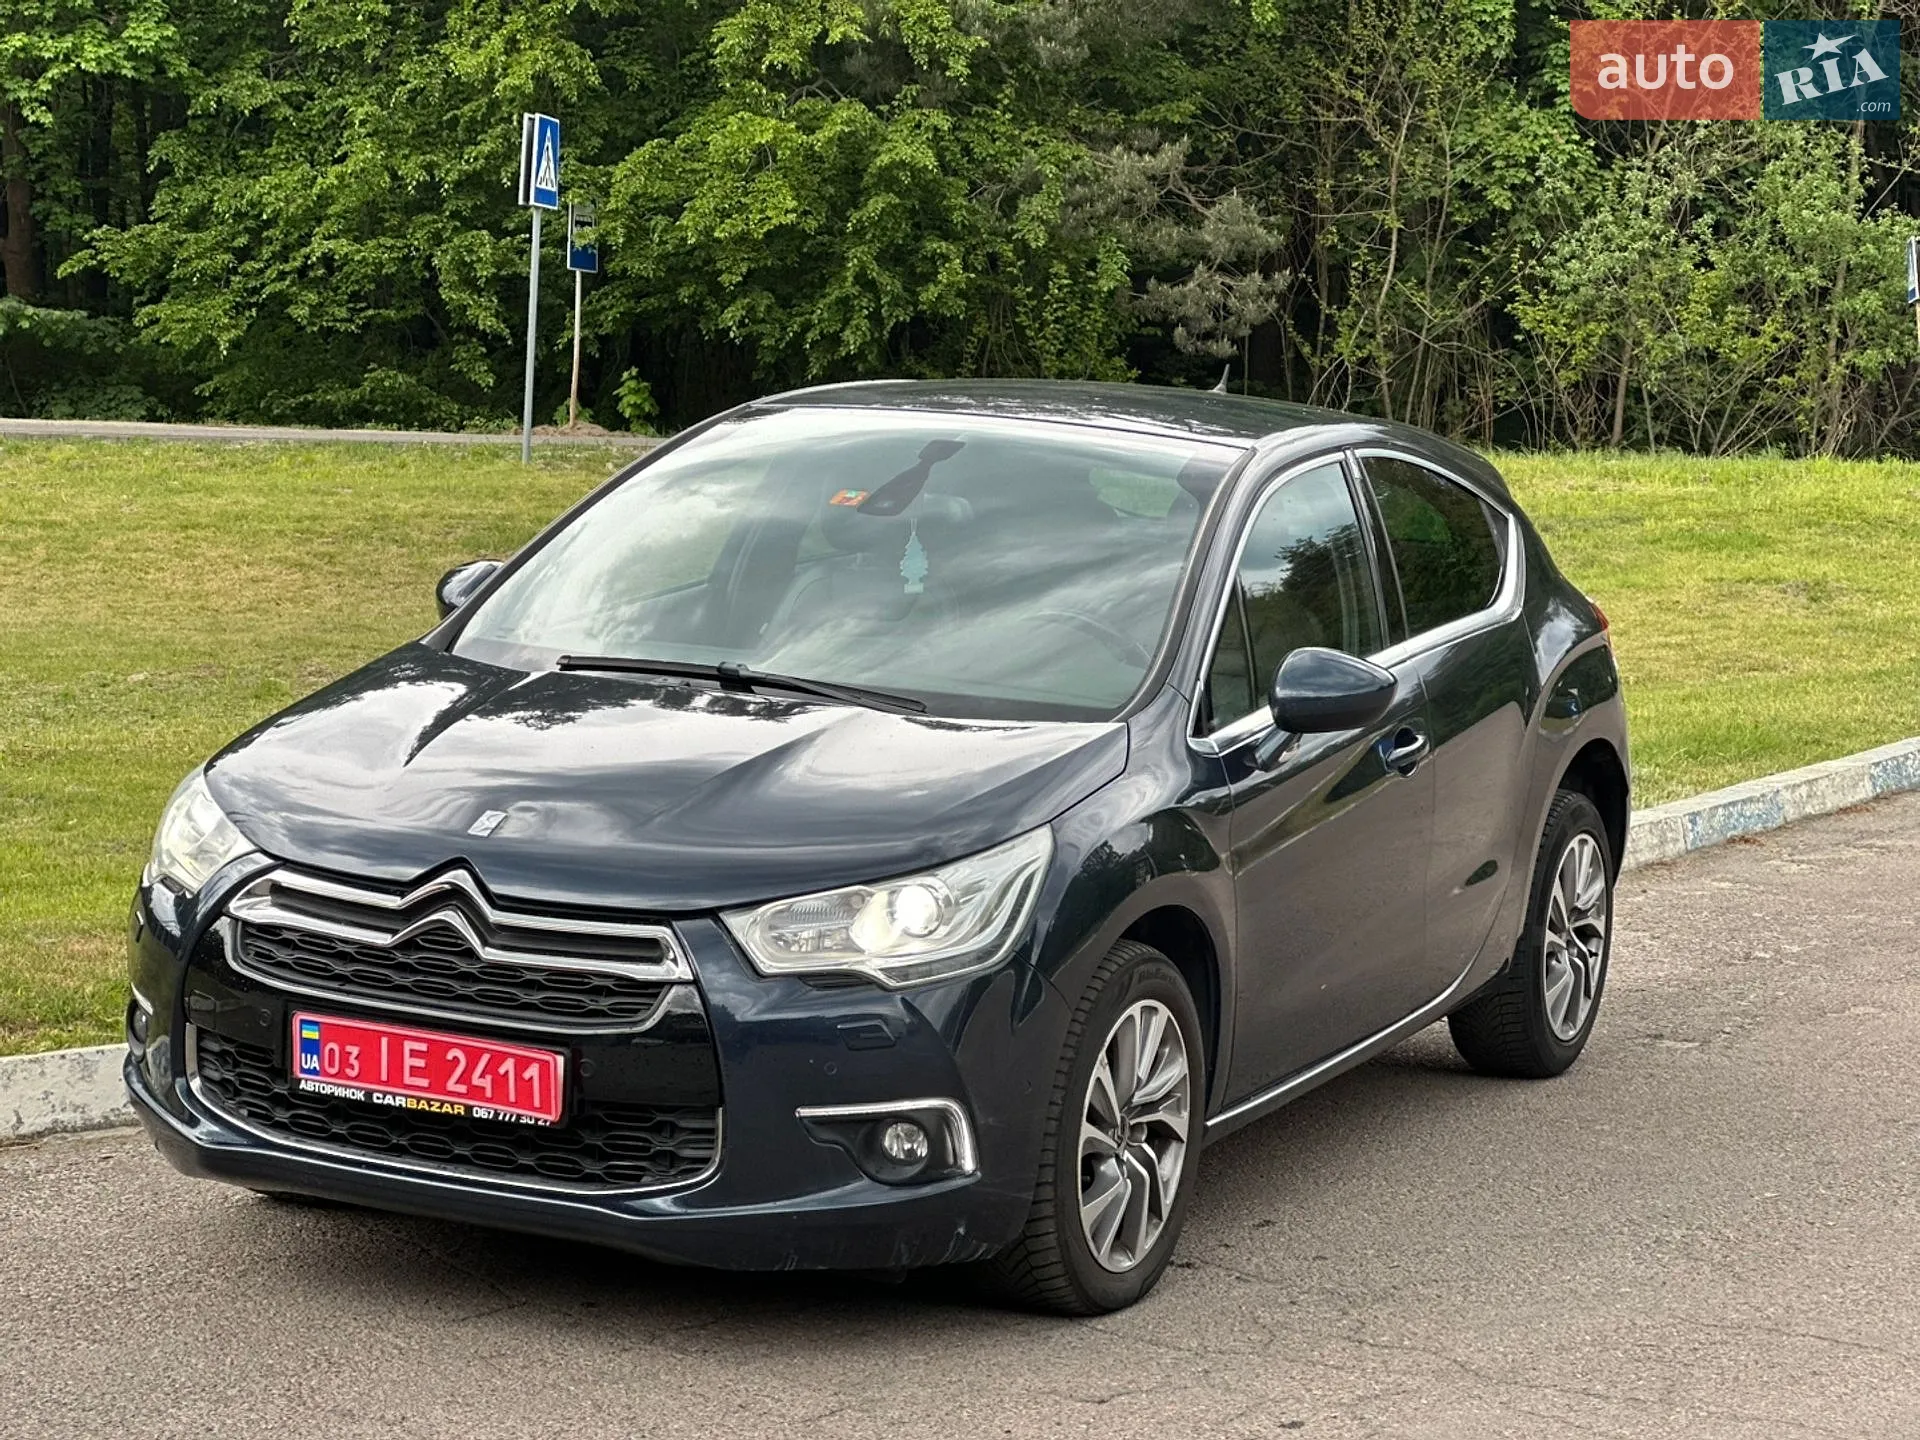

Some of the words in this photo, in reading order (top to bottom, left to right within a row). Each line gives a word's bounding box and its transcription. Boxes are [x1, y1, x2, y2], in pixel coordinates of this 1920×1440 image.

[301, 1052, 320, 1071] UA
[323, 1042, 361, 1078] 03
[445, 1048, 542, 1108] 2411
[299, 1079, 365, 1102] АВТОРИНОК
[372, 1092, 465, 1116] CARBAZAR
[472, 1106, 494, 1120] 067
